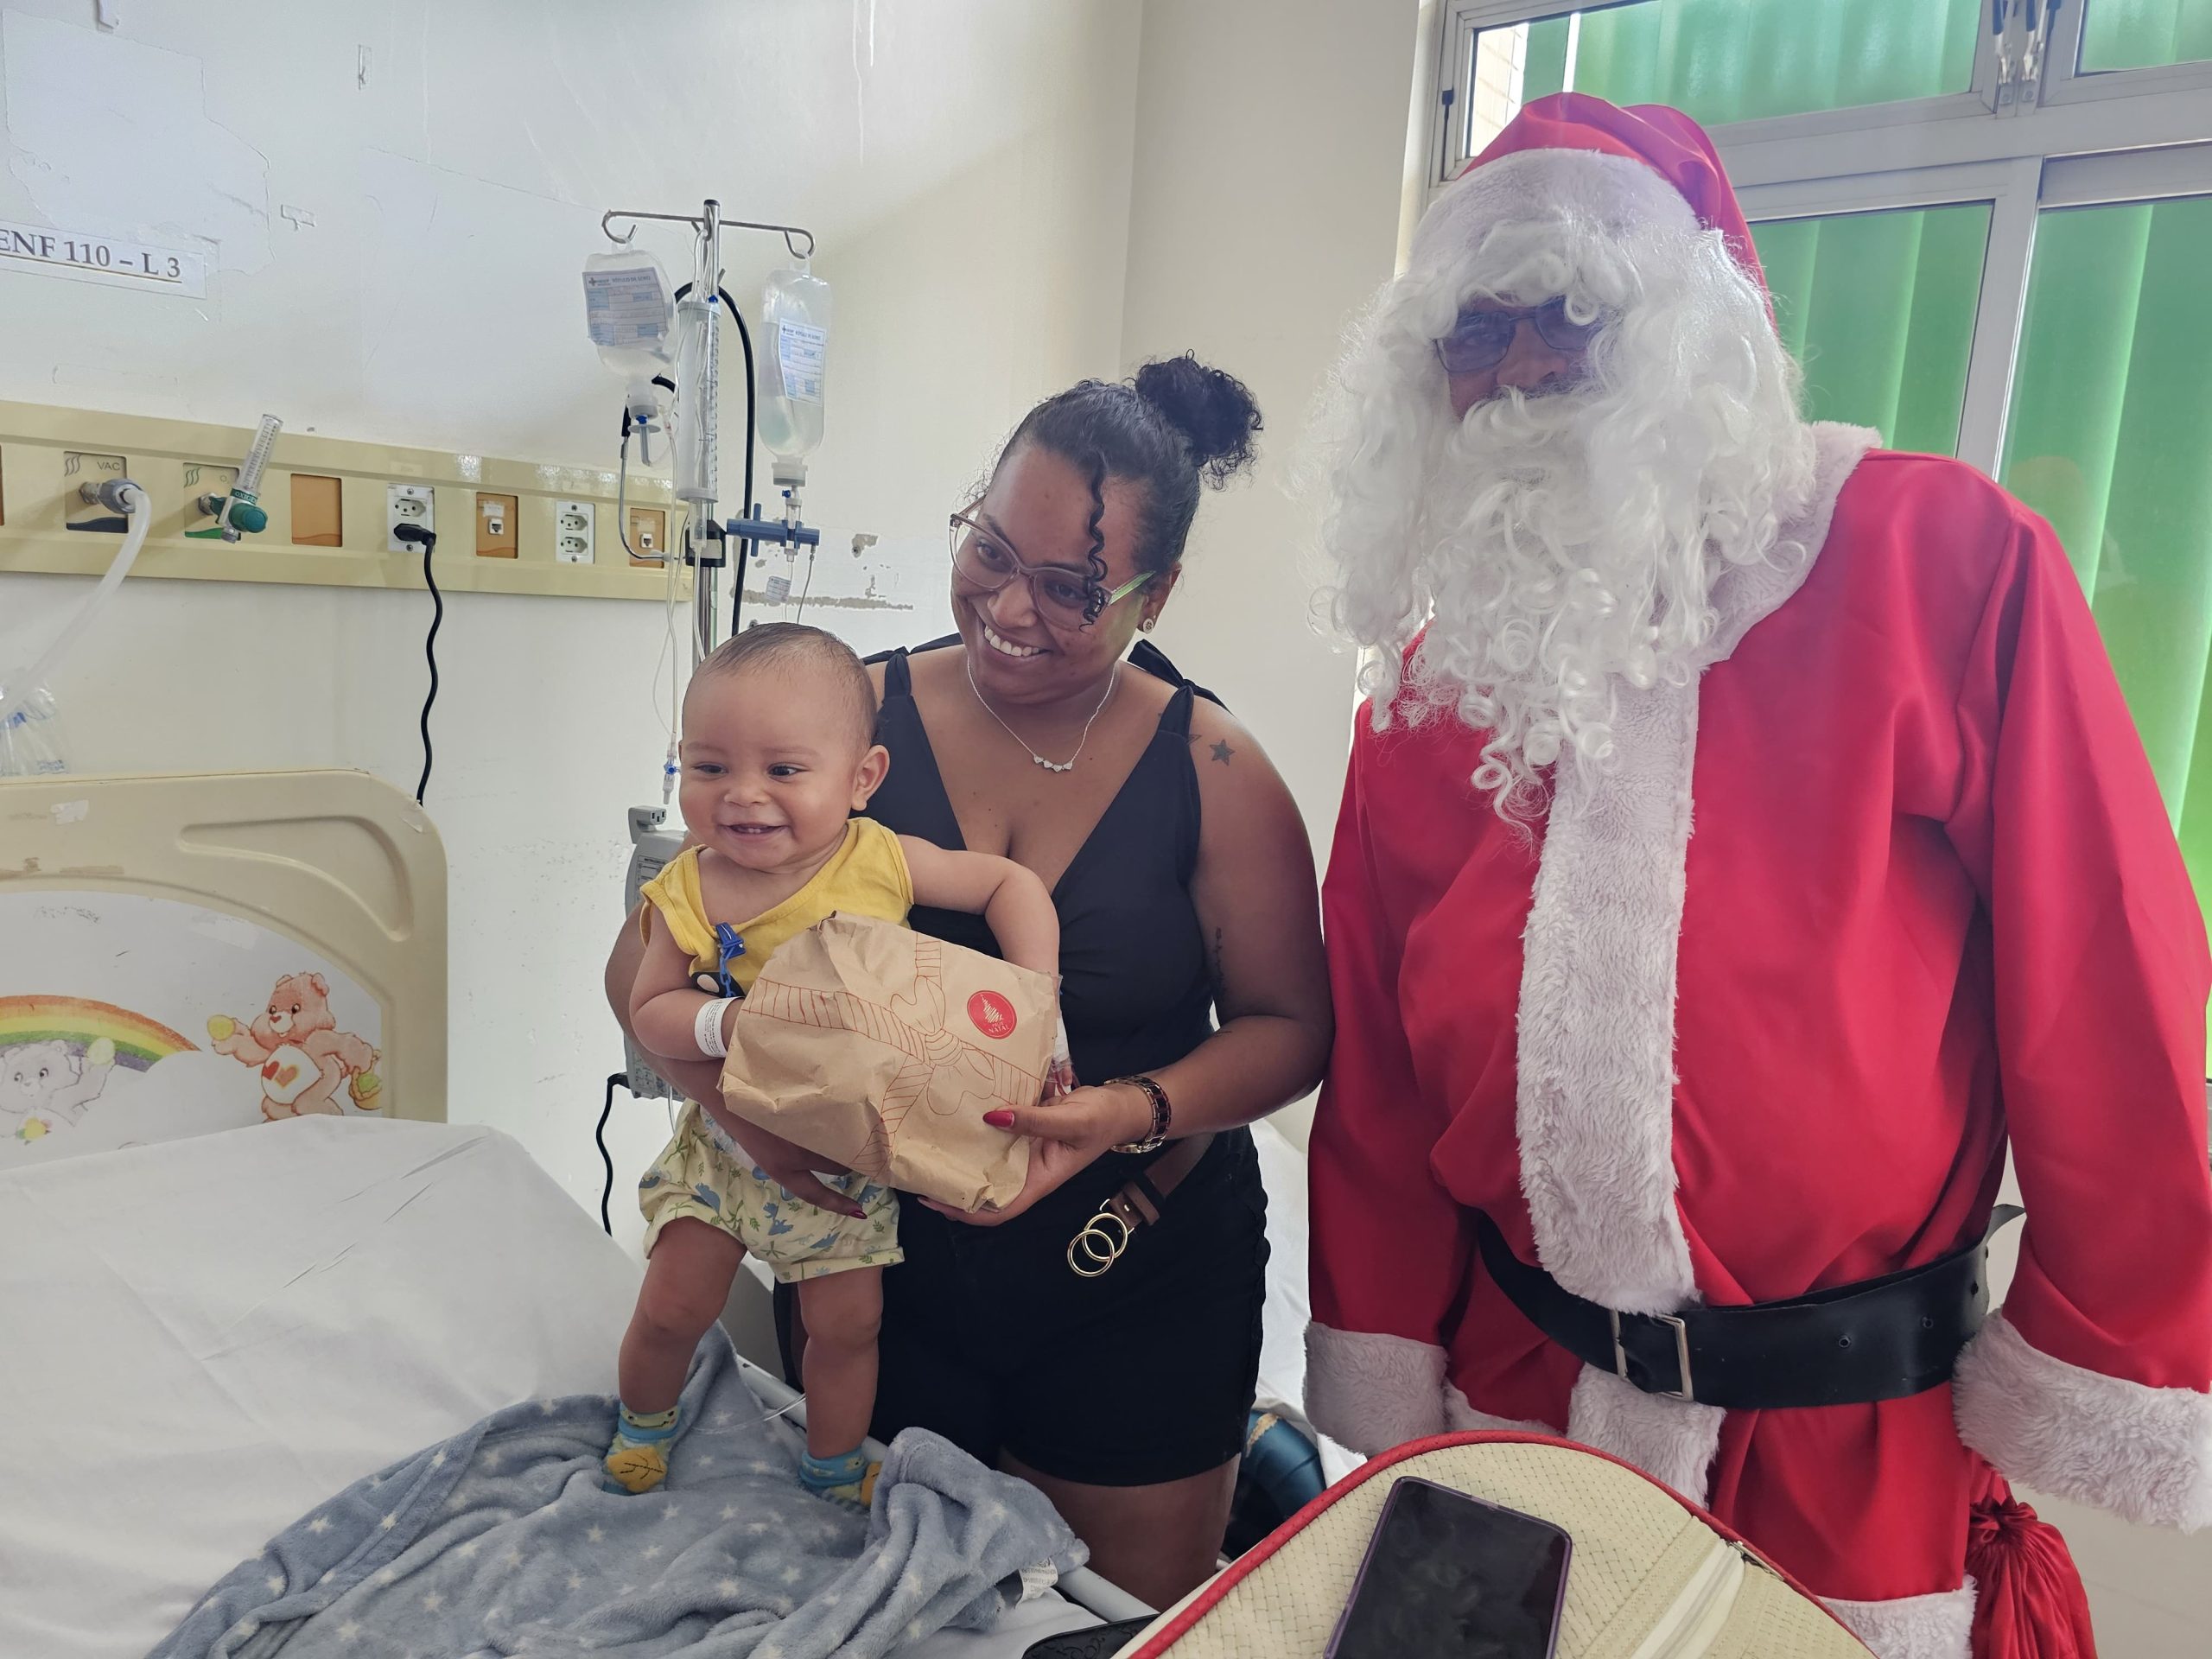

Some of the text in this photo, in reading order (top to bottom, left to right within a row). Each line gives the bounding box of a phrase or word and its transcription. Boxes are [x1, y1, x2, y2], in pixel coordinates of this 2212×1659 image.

[0, 229, 56, 257] ENF
[64, 240, 111, 267] 110
[142, 252, 159, 275] L
[167, 257, 181, 277] 3
[97, 461, 120, 470] VAC
[988, 1024, 1010, 1033] NATAL
